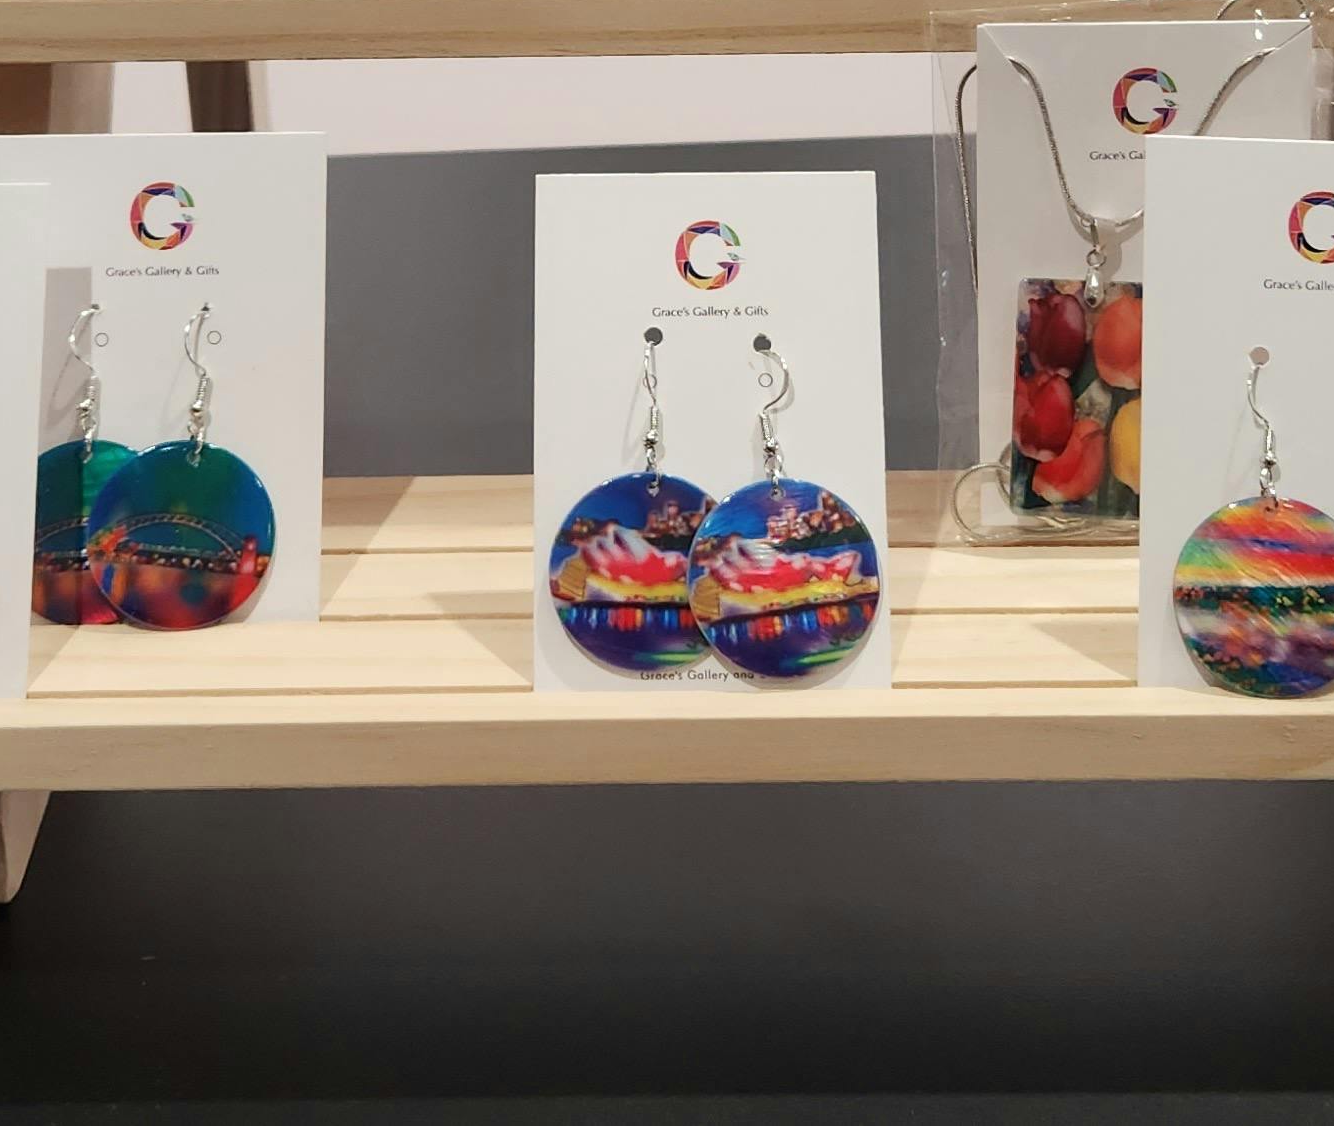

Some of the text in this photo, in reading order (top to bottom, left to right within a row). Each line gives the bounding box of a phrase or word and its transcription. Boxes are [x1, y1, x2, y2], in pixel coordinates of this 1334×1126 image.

[1089, 151, 1126, 161] Grace's
[106, 265, 219, 277] Grace's Gallery & Gifts
[1263, 279, 1302, 291] Grace's
[652, 306, 769, 318] Grace's Gallery & Gifts
[687, 670, 729, 682] Gallery
